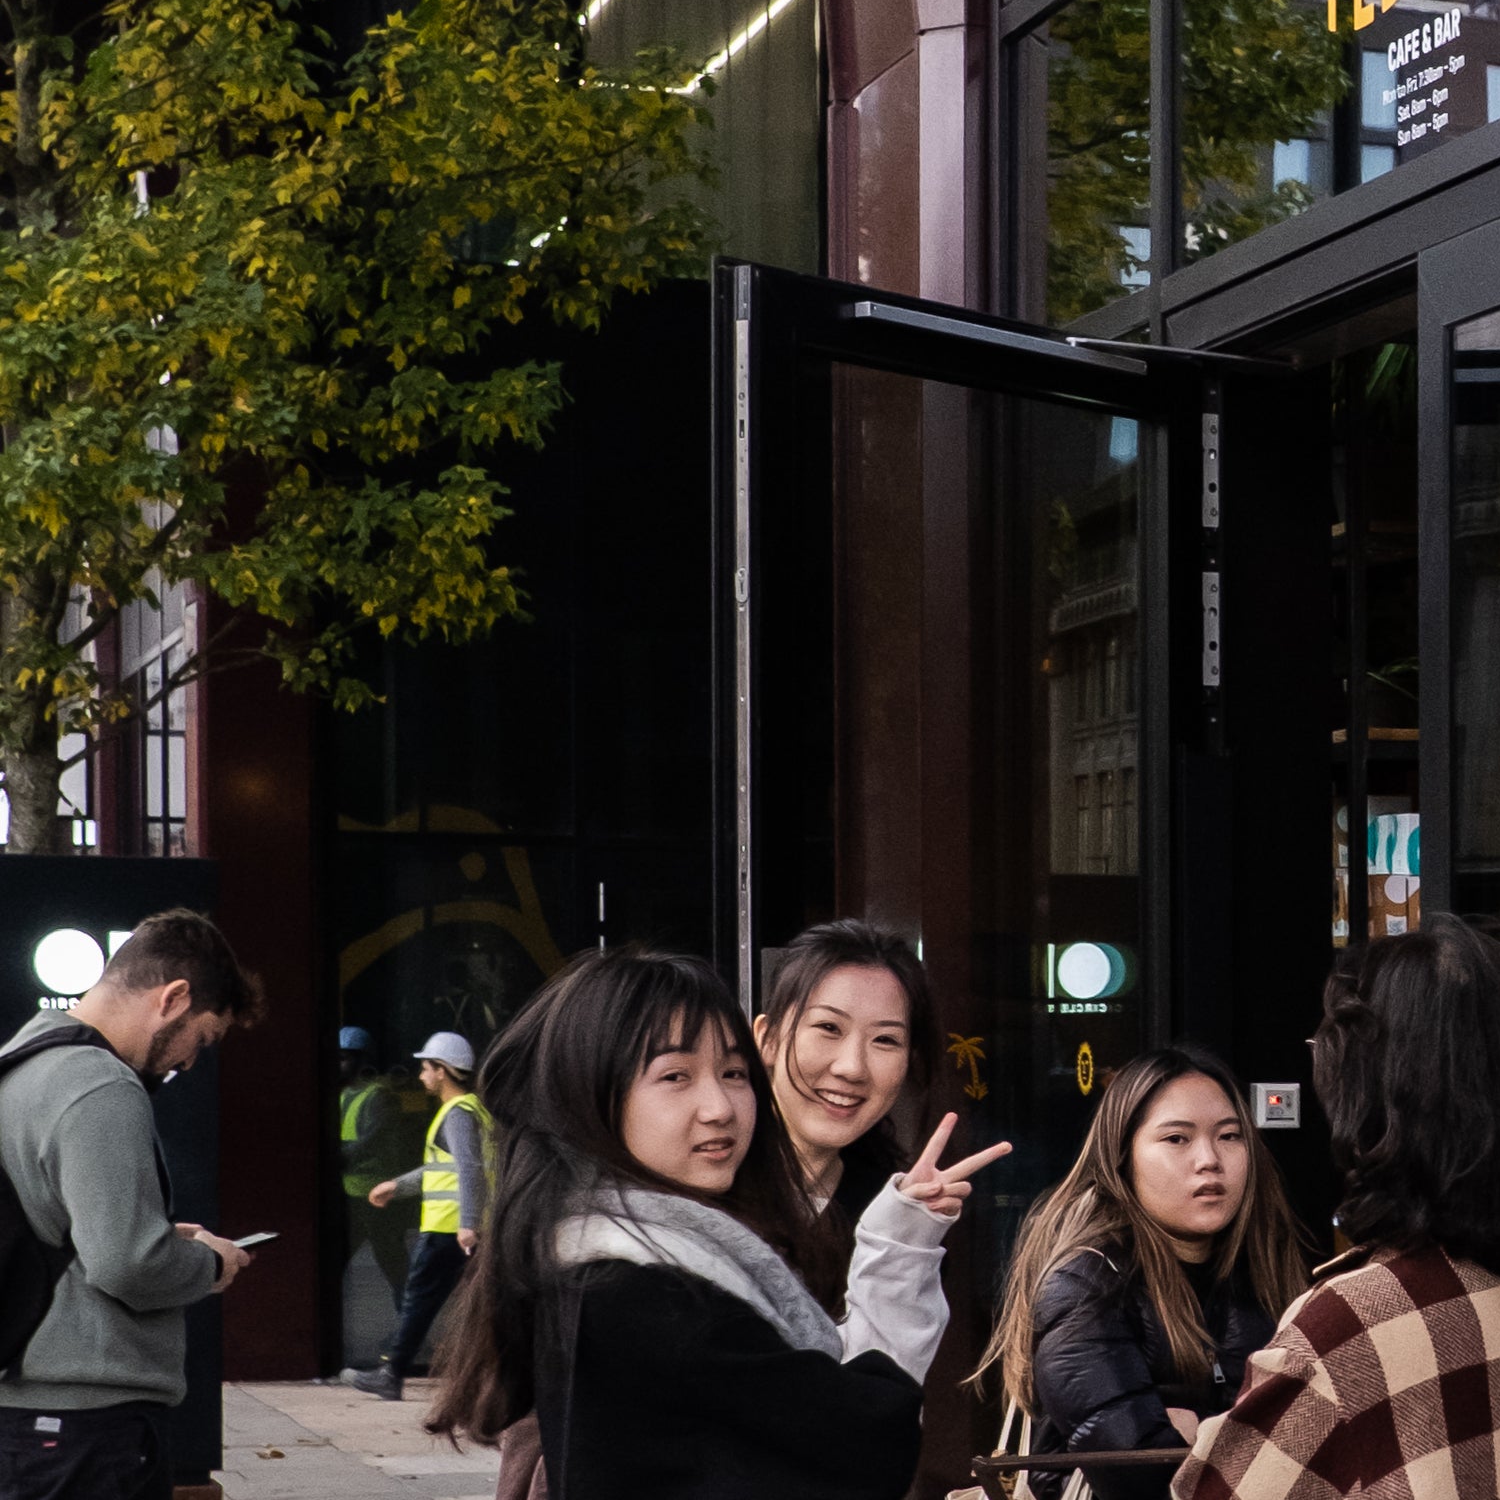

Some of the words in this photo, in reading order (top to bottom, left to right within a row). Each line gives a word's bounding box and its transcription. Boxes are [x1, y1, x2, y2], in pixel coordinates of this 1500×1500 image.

[1388, 28, 1420, 71] CAFE
[1421, 23, 1432, 54] &
[1433, 8, 1461, 48] BAR
[1406, 75, 1418, 94] Fri
[1398, 103, 1410, 122] Sat
[1398, 130, 1411, 146] Sun
[38, 996, 80, 1010] CIRC
